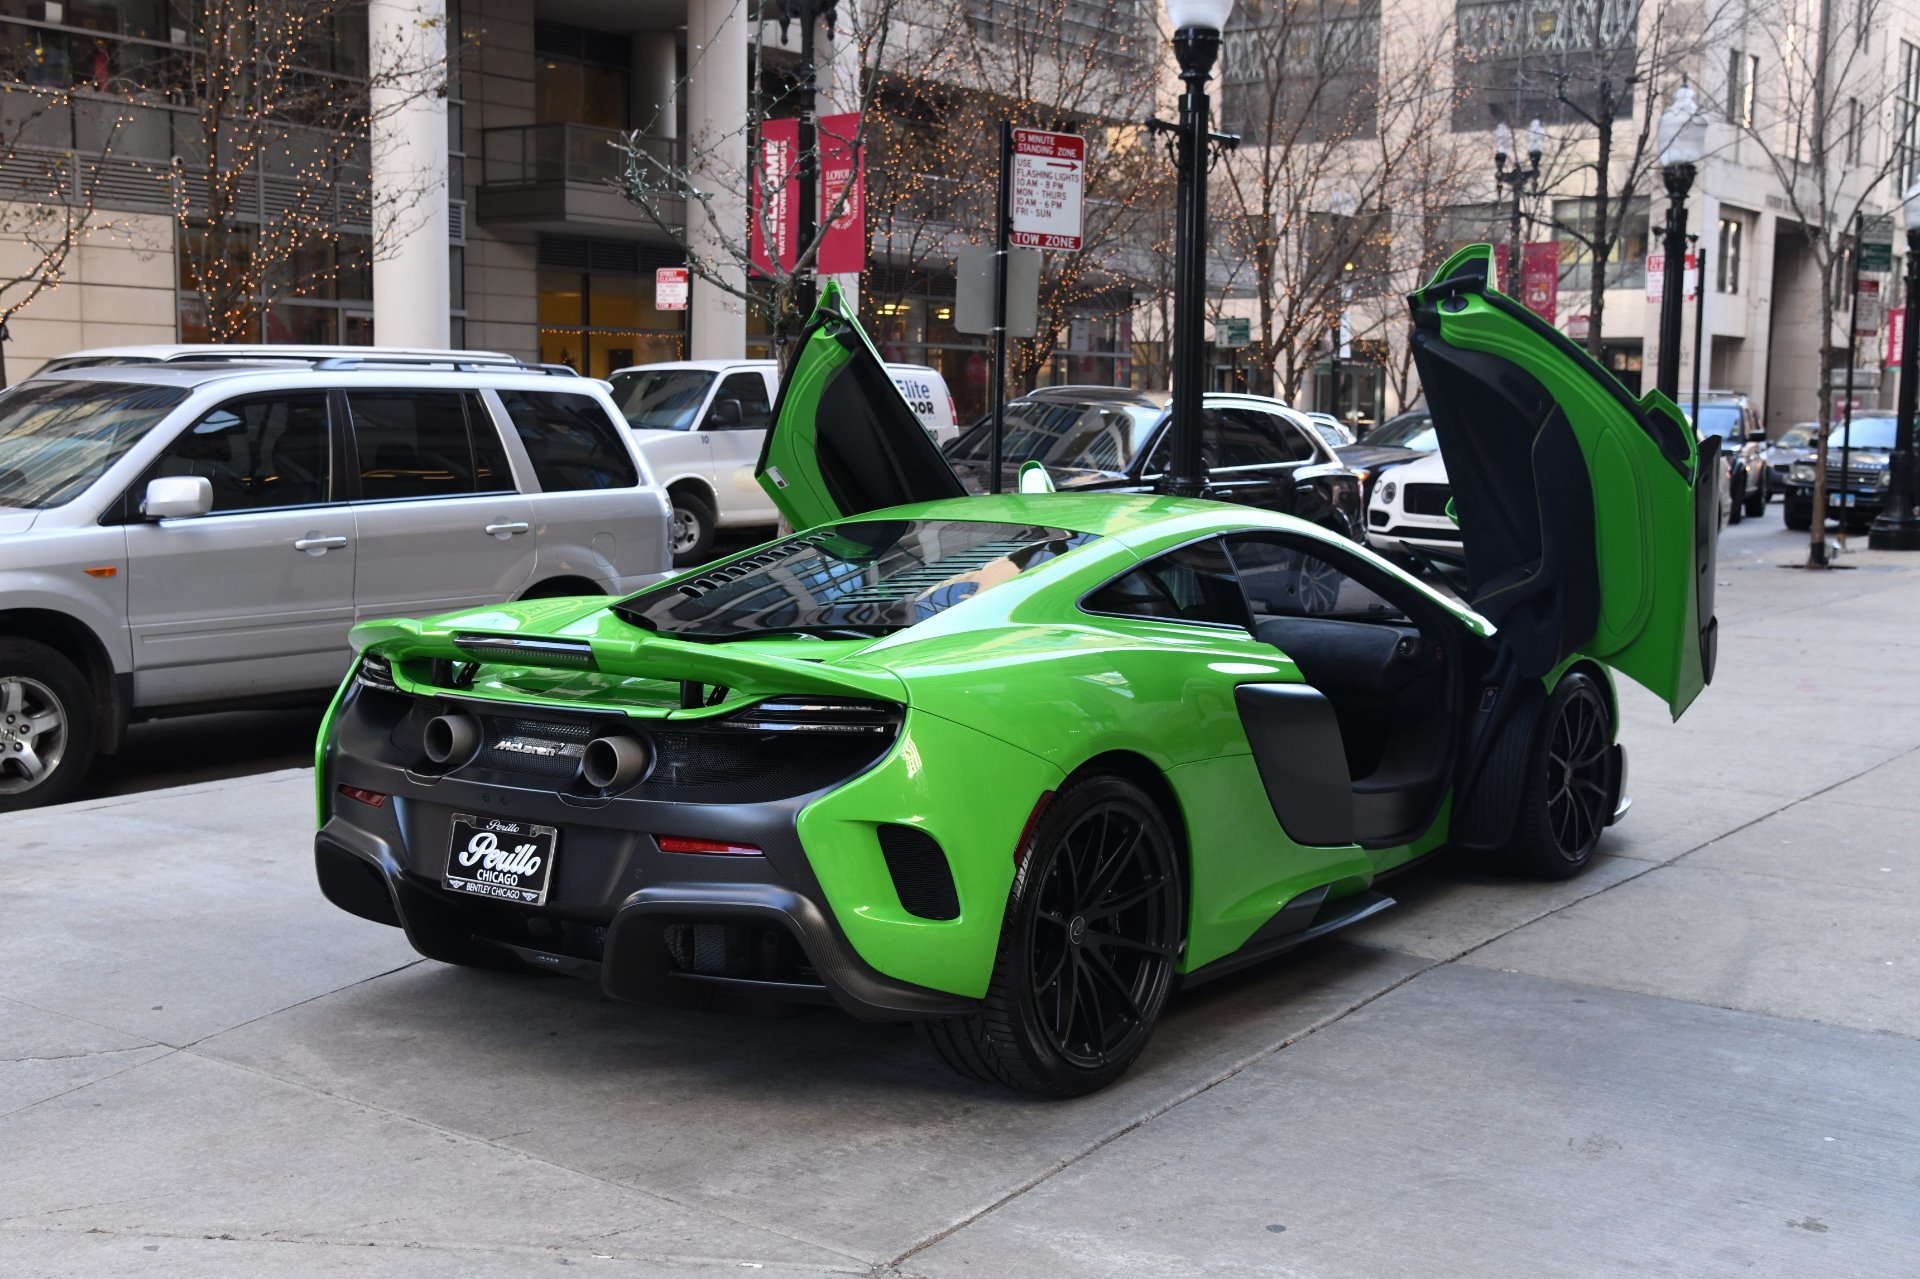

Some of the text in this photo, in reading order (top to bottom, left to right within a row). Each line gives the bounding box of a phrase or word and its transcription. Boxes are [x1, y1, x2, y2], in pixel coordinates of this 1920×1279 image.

[1018, 132, 1055, 146] 15 MINUTE
[1018, 143, 1077, 158] STANDING ZONE
[1017, 159, 1032, 168] USE
[1017, 168, 1079, 183] FLASHING LIGHTS
[1052, 181, 1064, 190] PM
[1016, 187, 1033, 196] MON
[1042, 190, 1067, 200] THURS
[1051, 201, 1062, 209] PM
[1016, 207, 1028, 216] FRI
[1035, 209, 1052, 218] SUN
[1015, 232, 1075, 249] TOW ZONE
[493, 740, 556, 757] McLaren
[486, 820, 520, 833] Perillo
[458, 832, 541, 876] Perillo
[476, 869, 518, 886] CHICAGO
[466, 882, 520, 899] BENTLEY CHICAGO
